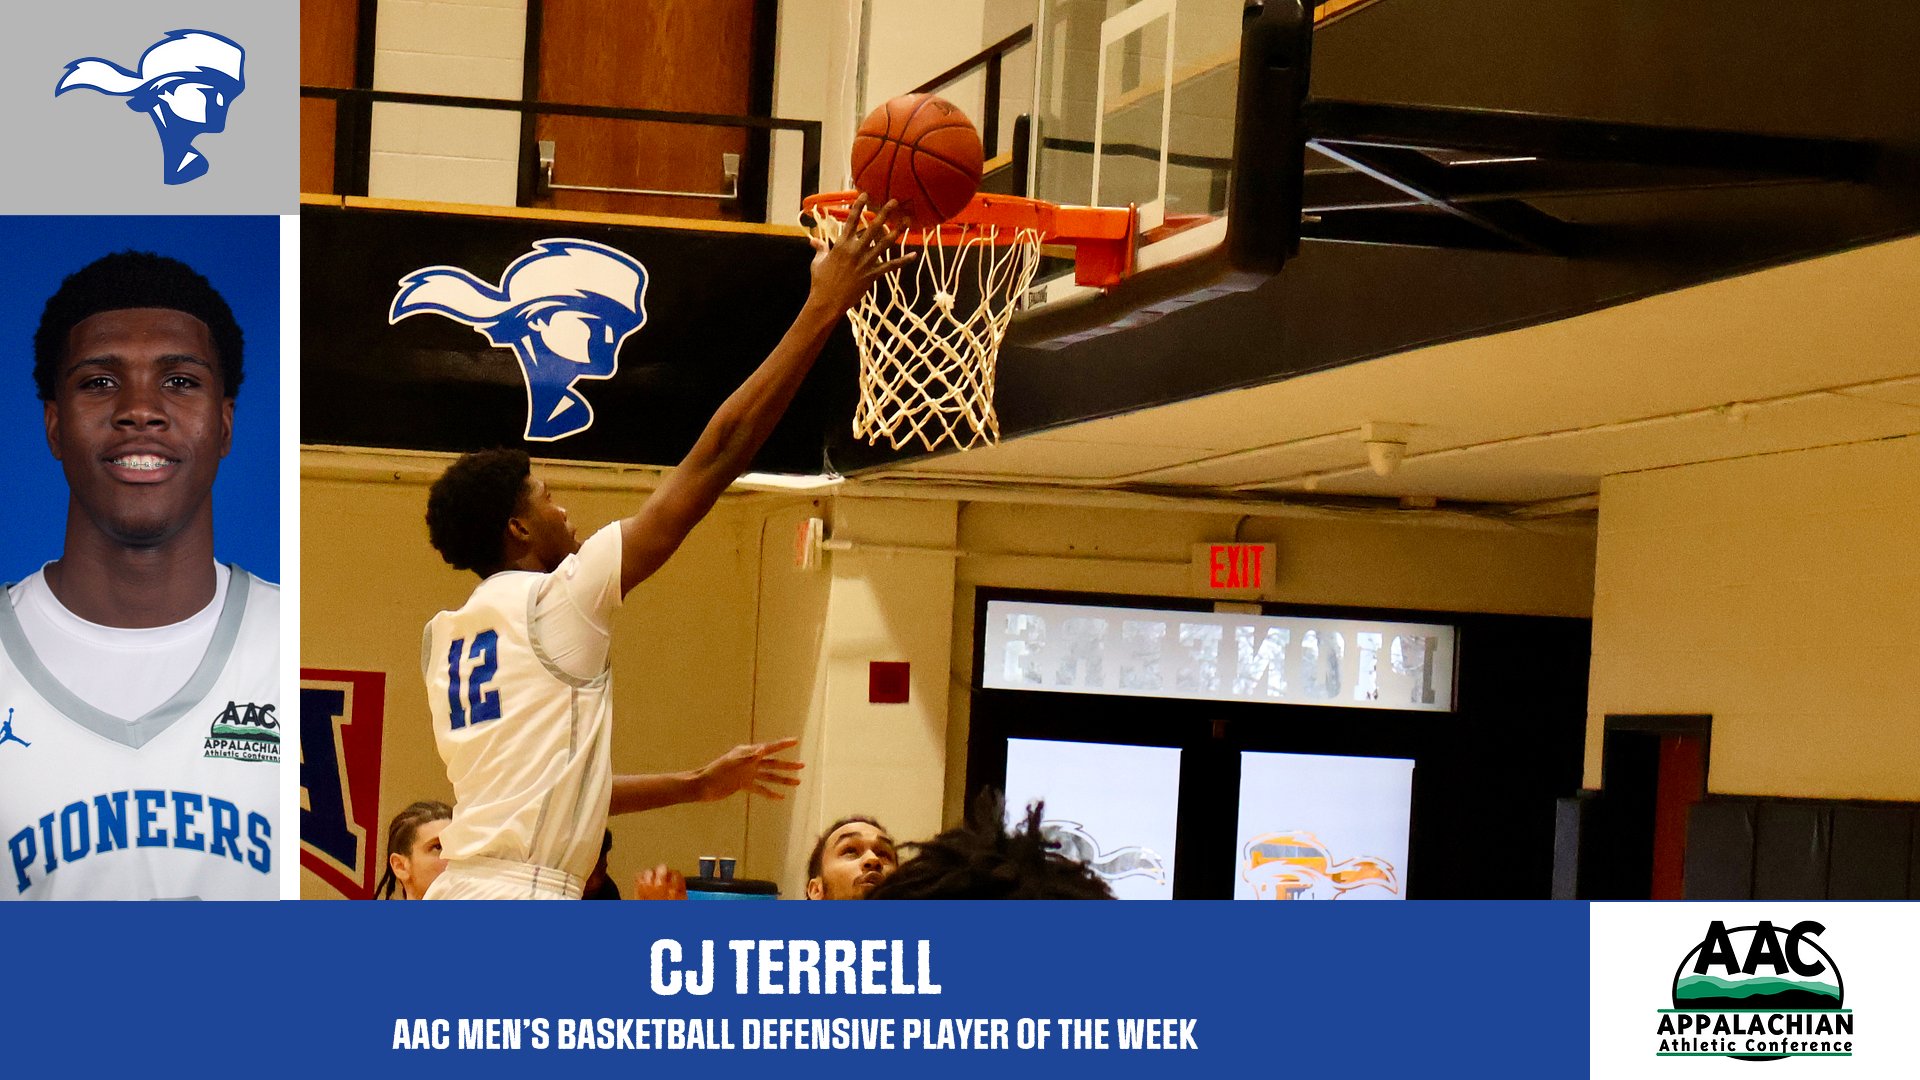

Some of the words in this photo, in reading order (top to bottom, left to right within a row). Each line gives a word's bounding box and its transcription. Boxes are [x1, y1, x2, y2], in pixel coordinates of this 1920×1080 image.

[1209, 544, 1265, 590] EXIT
[448, 628, 501, 731] 12
[221, 701, 277, 729] AAC
[205, 749, 239, 758] Athletic
[7, 789, 272, 895] PIONEERS
